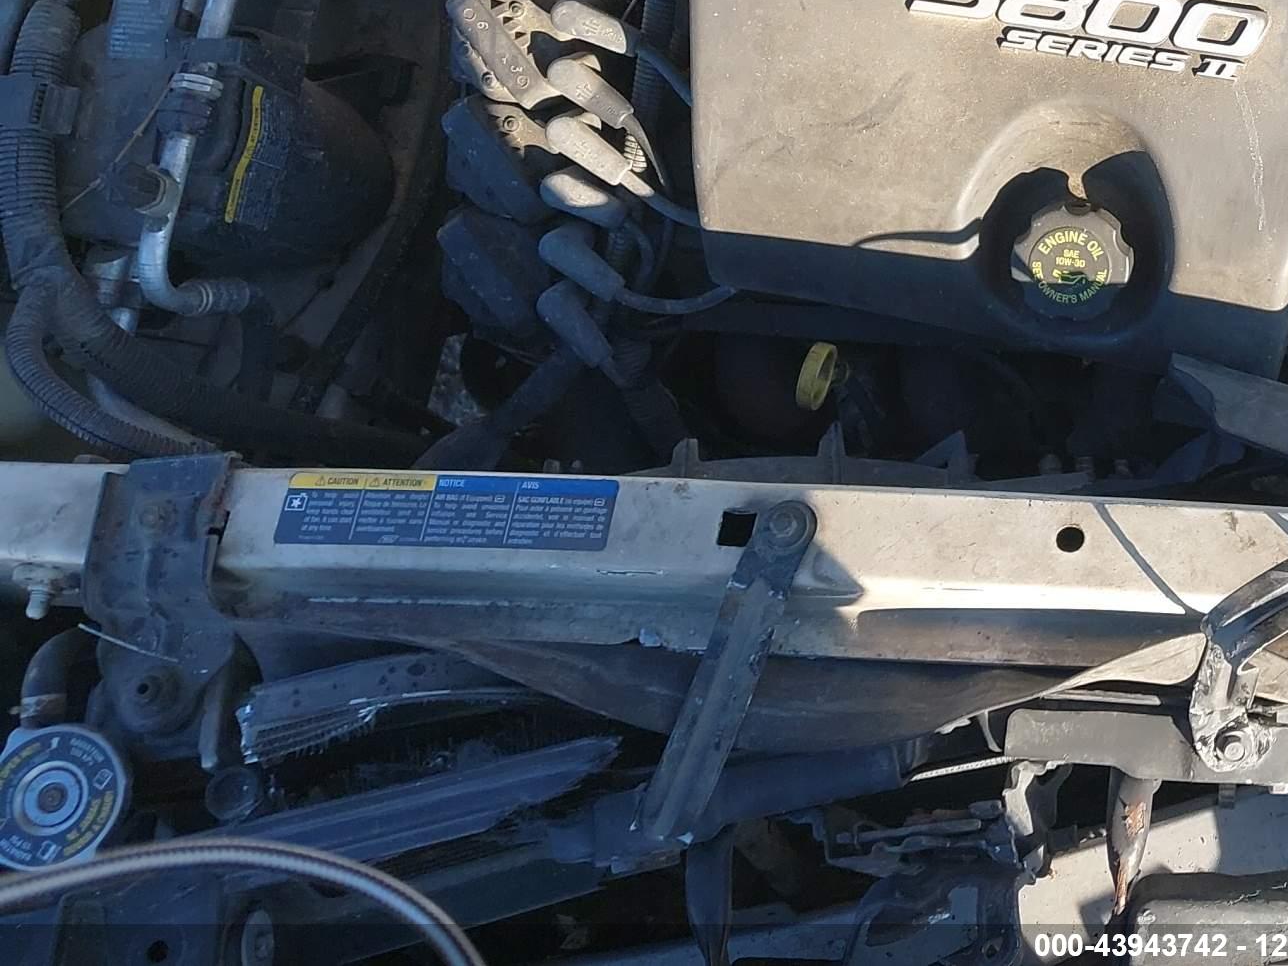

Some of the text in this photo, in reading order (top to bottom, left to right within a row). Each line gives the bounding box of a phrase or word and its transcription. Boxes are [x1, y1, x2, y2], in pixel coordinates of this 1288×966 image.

[996, 25, 1246, 83] SERIES II
[1038, 230, 1104, 260] ENGINE OIL
[1063, 249, 1080, 258] SAE
[1055, 256, 1086, 268] 10W-30
[1031, 261, 1108, 304] SEE OWNER'S MANUAL
[327, 477, 359, 486] CAUTION
[383, 478, 423, 488] ATTENTION
[438, 479, 465, 488] NOTICE
[521, 481, 541, 490] AVIS
